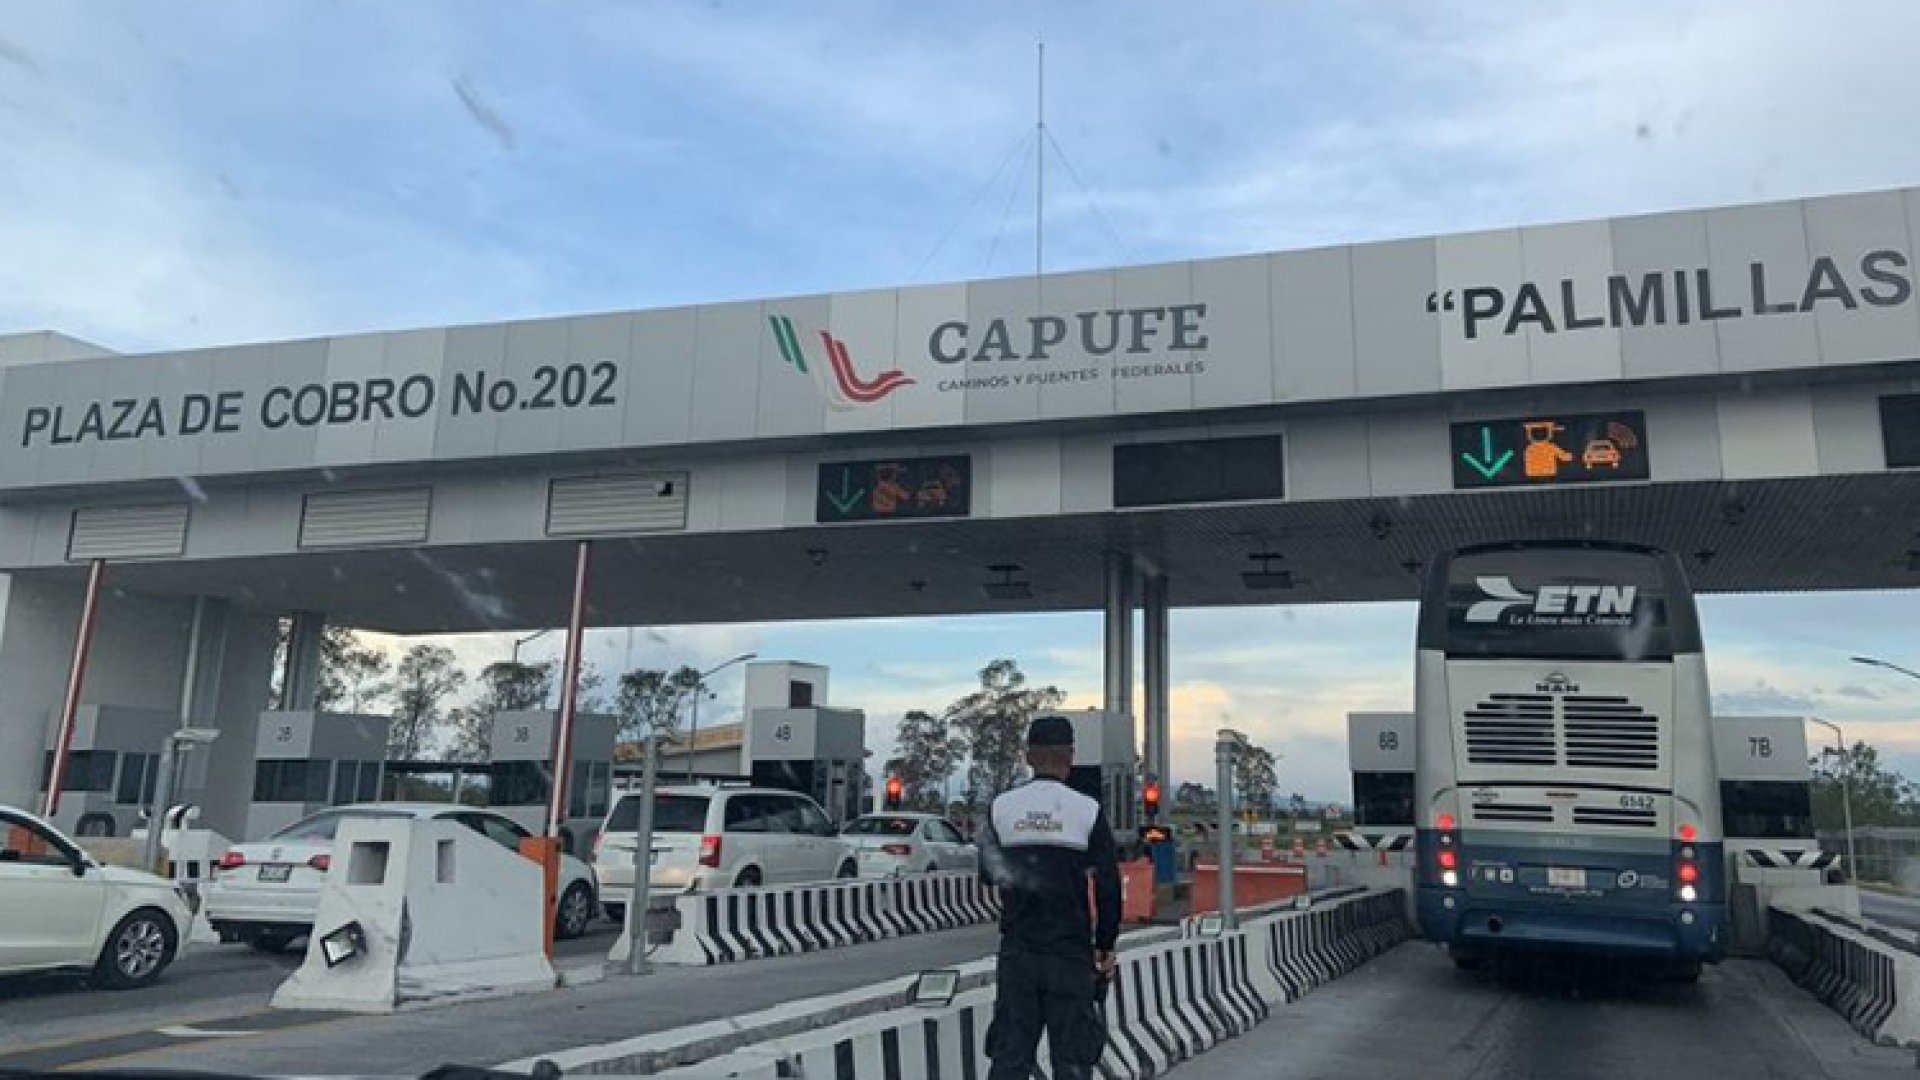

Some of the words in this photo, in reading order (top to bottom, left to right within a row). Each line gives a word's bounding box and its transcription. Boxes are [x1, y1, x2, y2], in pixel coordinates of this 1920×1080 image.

[928, 303, 1209, 364] CAPUFE
[937, 375, 1009, 392] CAMINOS
[1013, 375, 1022, 385] Y
[1027, 367, 1099, 385] PUENTES
[1110, 361, 1206, 379] FEDERALES
[22, 396, 166, 447] PLAZA
[179, 391, 245, 436] DE
[260, 373, 435, 429] COBRO
[451, 360, 618, 417] No.202
[1535, 585, 1637, 614] ETN
[775, 724, 791, 742] 4B
[1748, 736, 1771, 758] 7B
